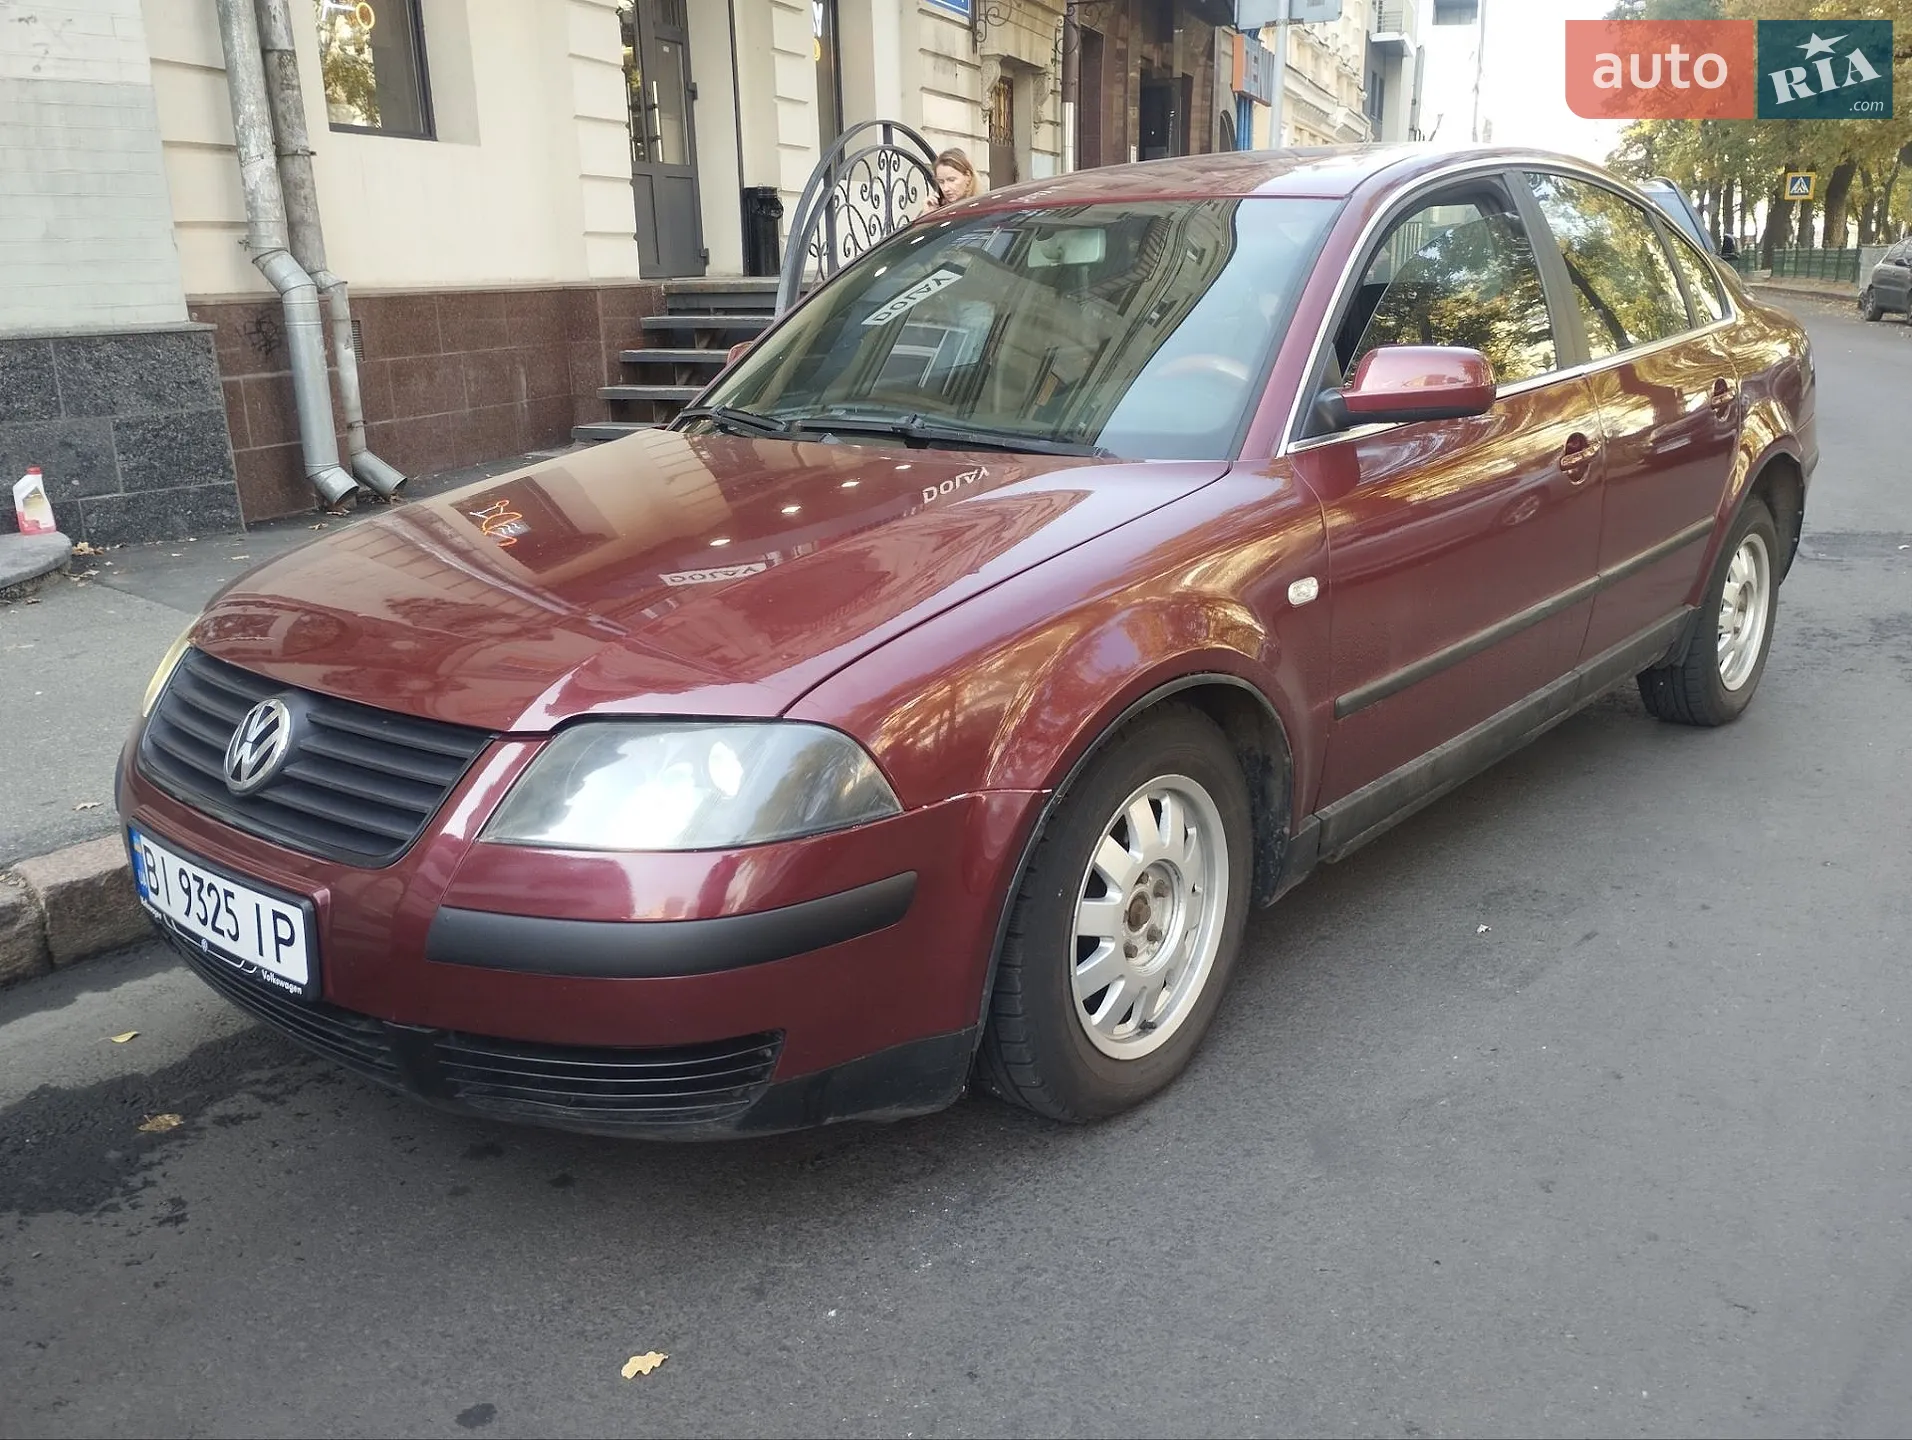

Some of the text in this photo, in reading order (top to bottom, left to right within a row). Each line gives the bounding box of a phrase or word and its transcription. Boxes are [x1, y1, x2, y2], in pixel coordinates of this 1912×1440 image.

[144, 845, 171, 906] BI
[178, 867, 240, 942] 9325
[255, 903, 296, 963] IP
[261, 968, 303, 996] Volkswagen
